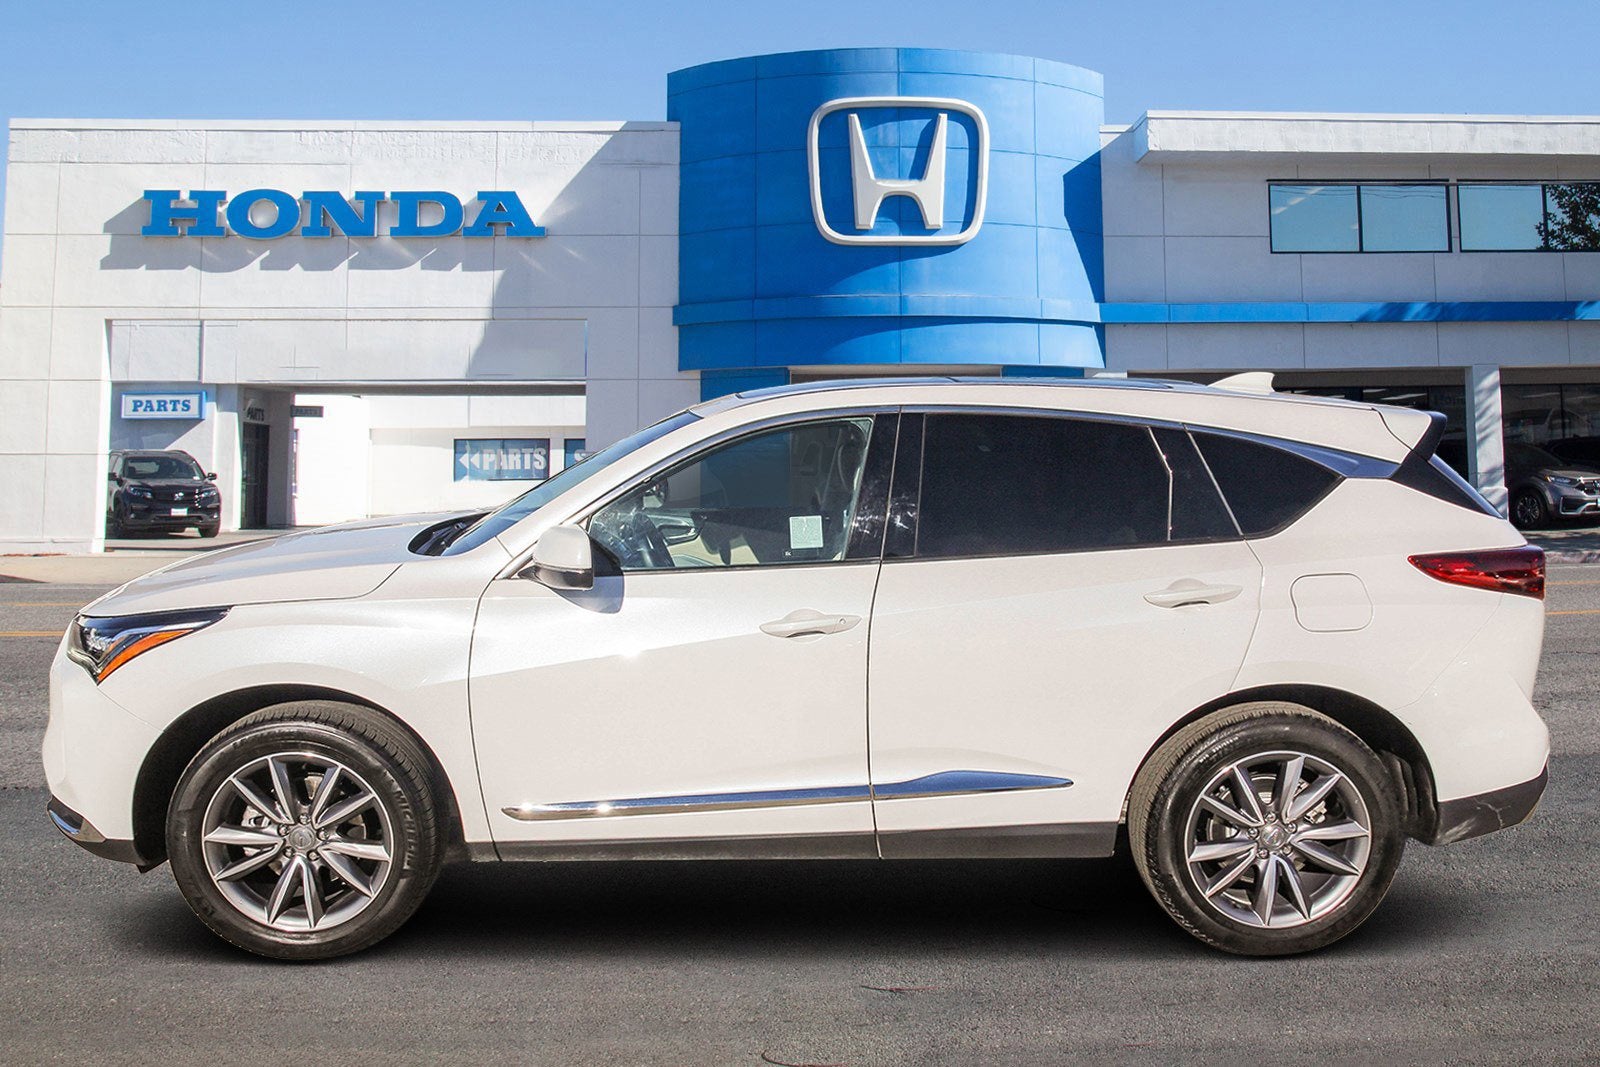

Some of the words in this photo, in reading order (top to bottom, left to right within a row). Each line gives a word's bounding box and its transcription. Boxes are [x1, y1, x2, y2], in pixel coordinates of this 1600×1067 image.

[141, 189, 547, 239] HONDA
[132, 399, 191, 412] PARTS
[482, 448, 547, 470] PARTS
